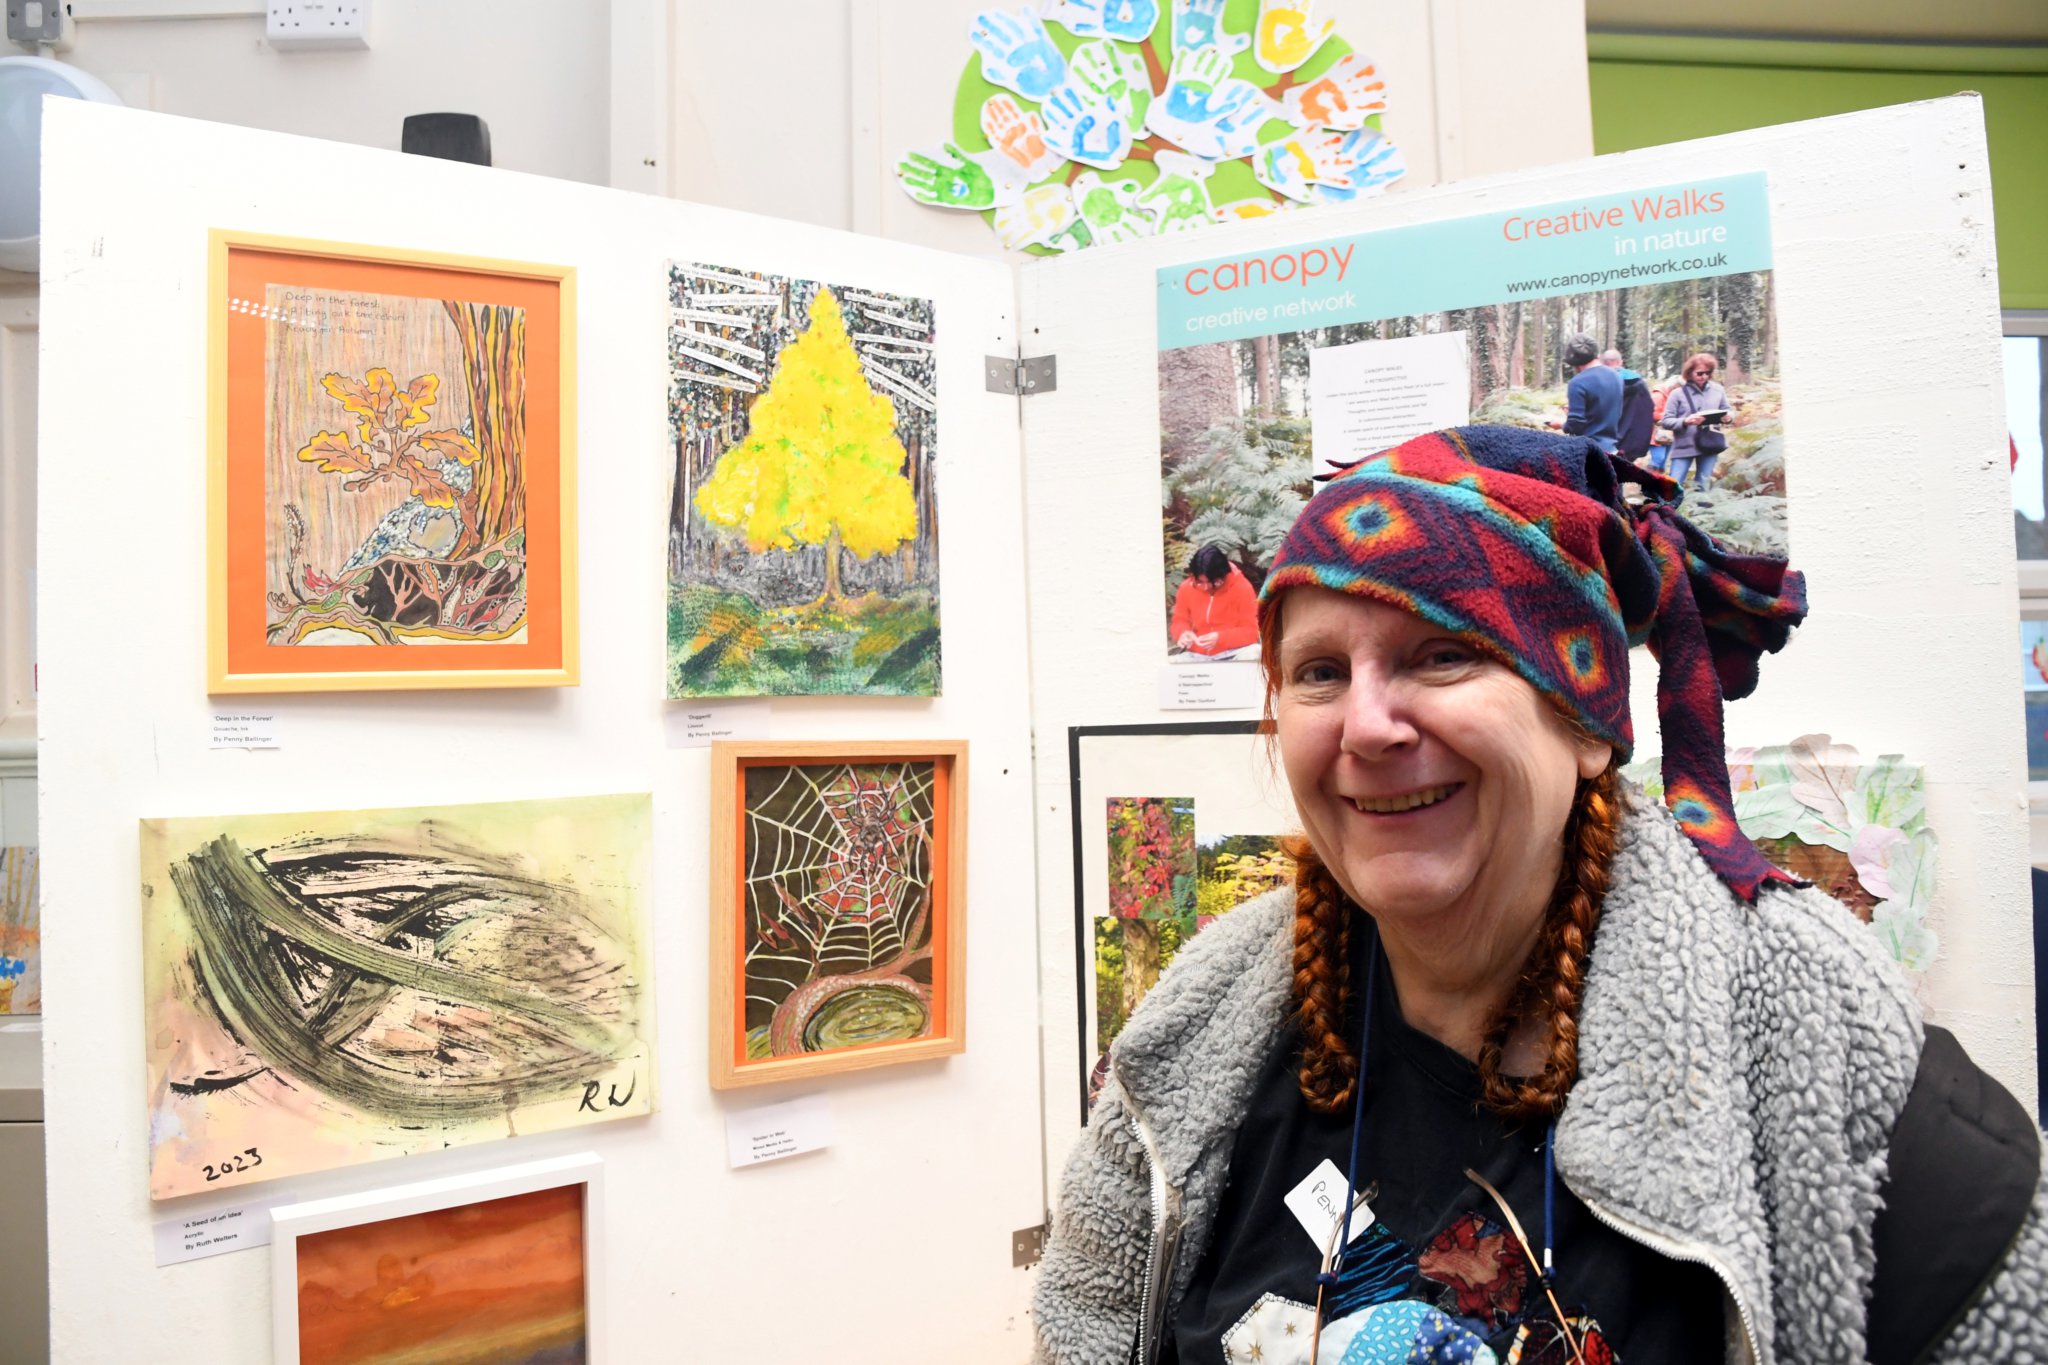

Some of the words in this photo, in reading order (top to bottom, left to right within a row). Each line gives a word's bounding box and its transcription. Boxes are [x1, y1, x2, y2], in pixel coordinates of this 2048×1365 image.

[1503, 206, 1623, 242] Creative
[1631, 188, 1726, 223] Walks
[1614, 235, 1637, 256] in
[1644, 225, 1728, 252] nature
[1184, 243, 1355, 296] canopy
[1506, 252, 1728, 294] www.canopynetwork.co.uk
[329, 295, 346, 306] the
[1186, 306, 1268, 332] creative
[1273, 290, 1357, 318] network
[202, 1147, 263, 1182] 2023
[191, 1219, 209, 1228] Seed
[196, 1239, 212, 1248] Ruth
